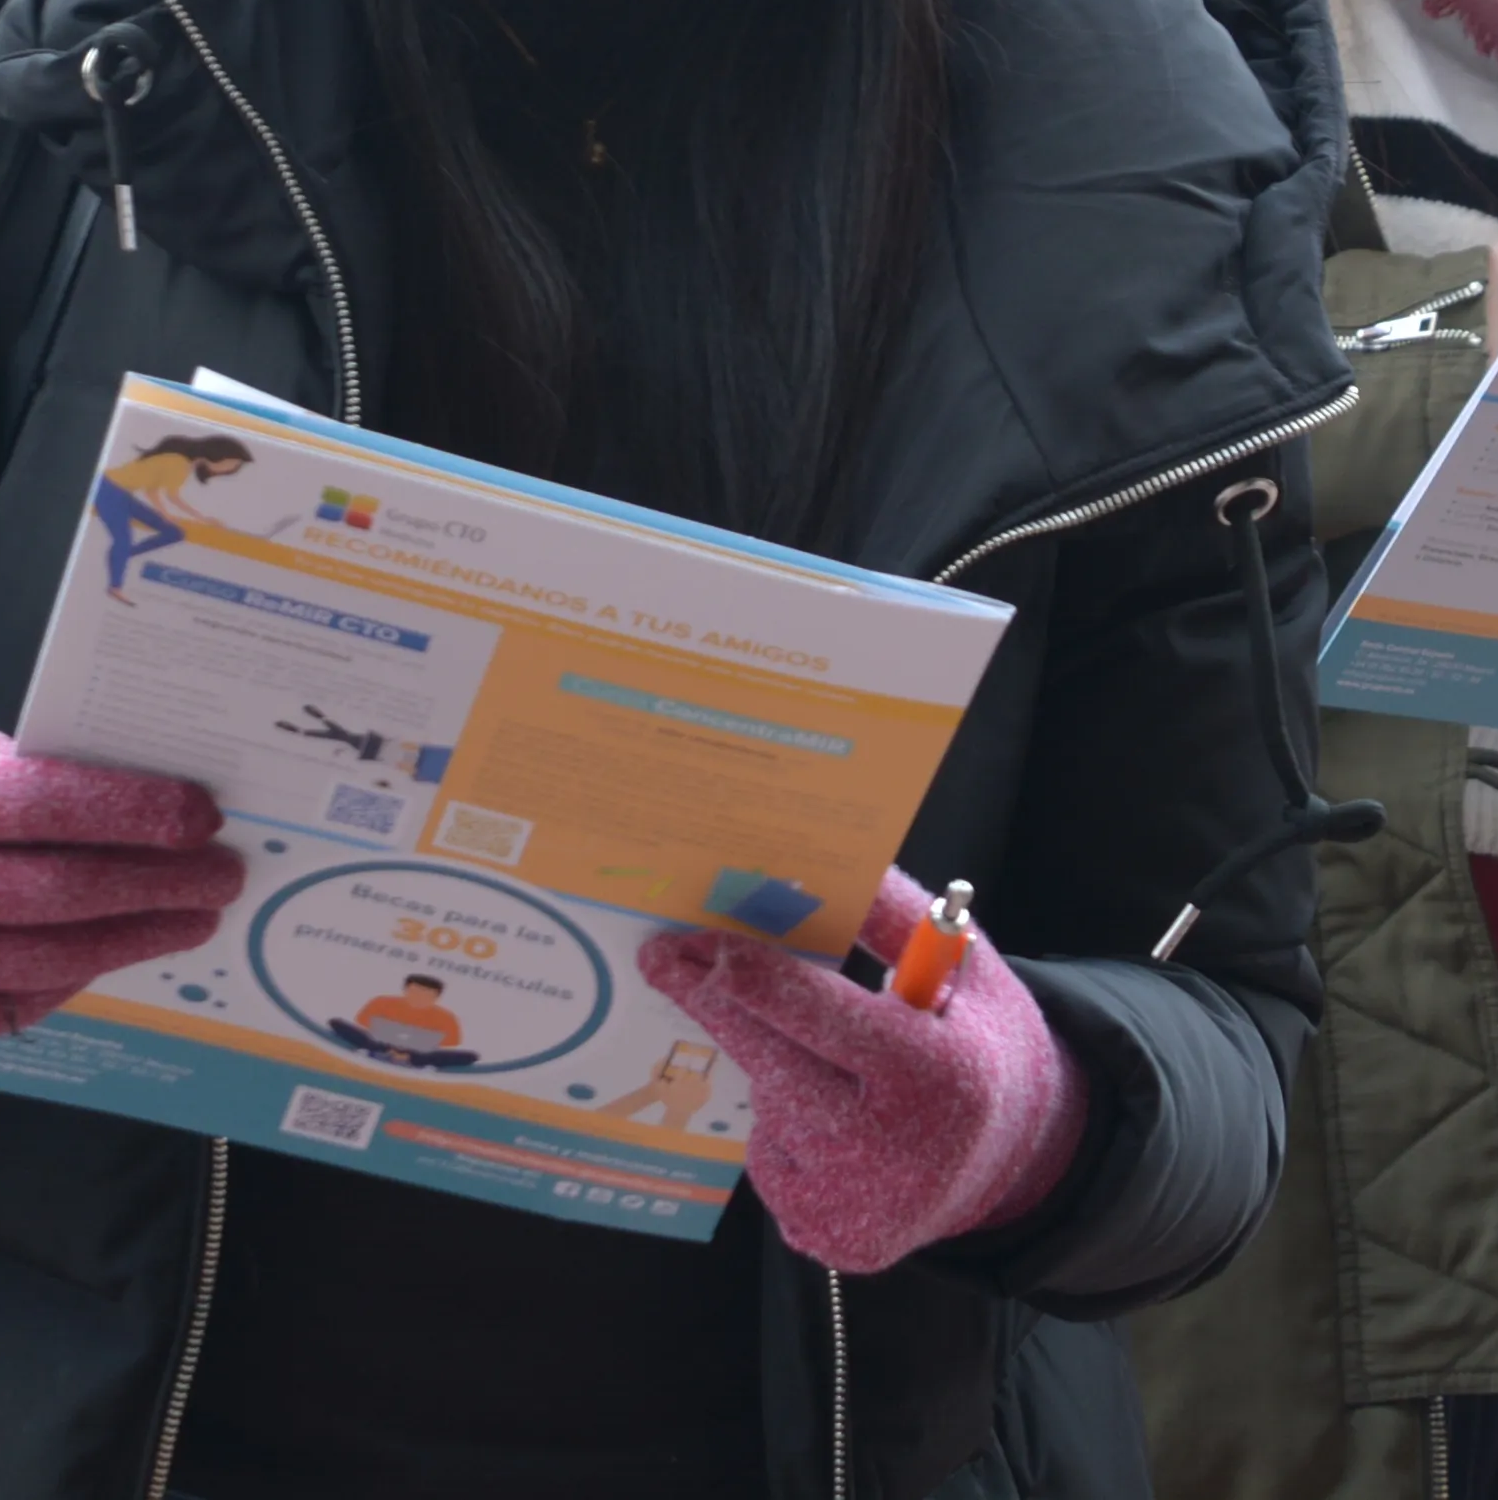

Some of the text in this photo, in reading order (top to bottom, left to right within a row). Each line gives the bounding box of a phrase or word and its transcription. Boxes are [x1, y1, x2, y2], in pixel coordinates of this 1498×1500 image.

[443, 520, 488, 544] CTO
[241, 588, 334, 626] ReMIR
[337, 616, 400, 642] CTO
[594, 603, 620, 624] A
[630, 609, 693, 640] TUS
[698, 630, 832, 674] AMIGOS
[349, 881, 556, 946] Becas para las
[292, 923, 421, 964] primeras
[391, 917, 498, 961] 300
